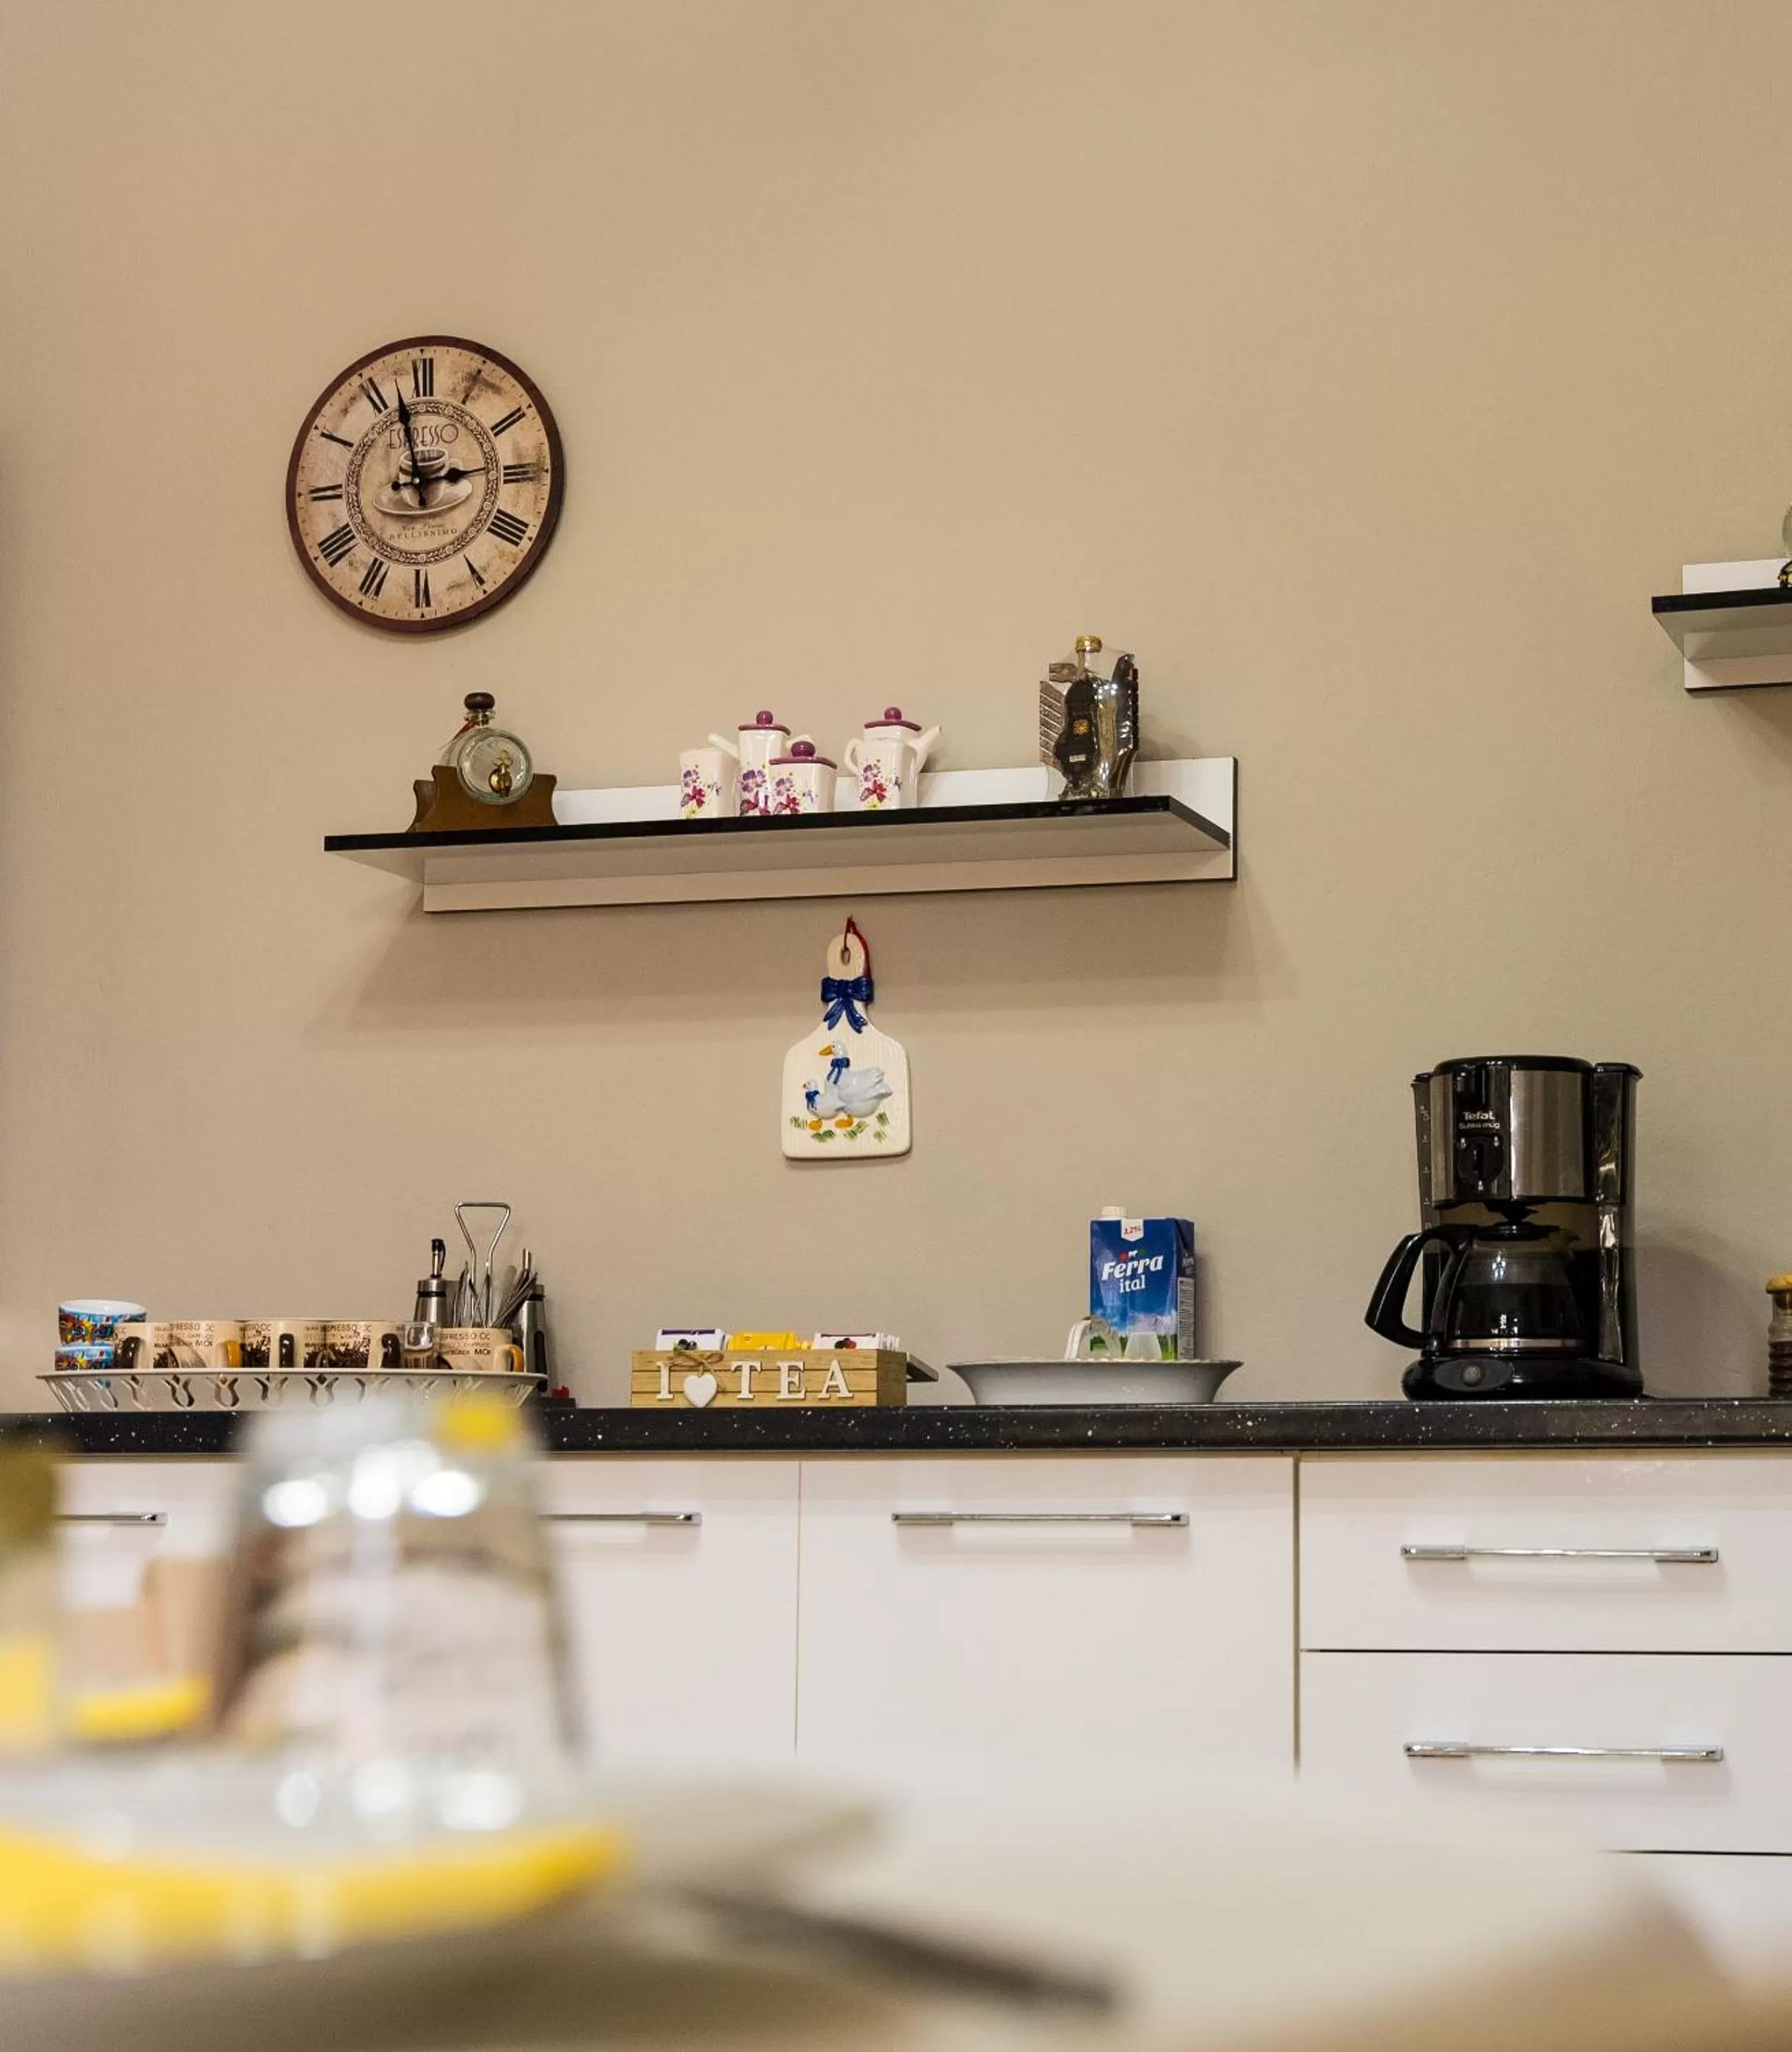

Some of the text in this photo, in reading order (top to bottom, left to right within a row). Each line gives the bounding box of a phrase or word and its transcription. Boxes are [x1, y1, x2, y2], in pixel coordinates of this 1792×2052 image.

[490, 406, 526, 438] II
[389, 423, 459, 449] ESRESSO
[503, 462, 538, 485] III
[1101, 1255, 1163, 1281] Ferra
[1120, 1275, 1146, 1293] ital
[657, 1361, 673, 1400] I
